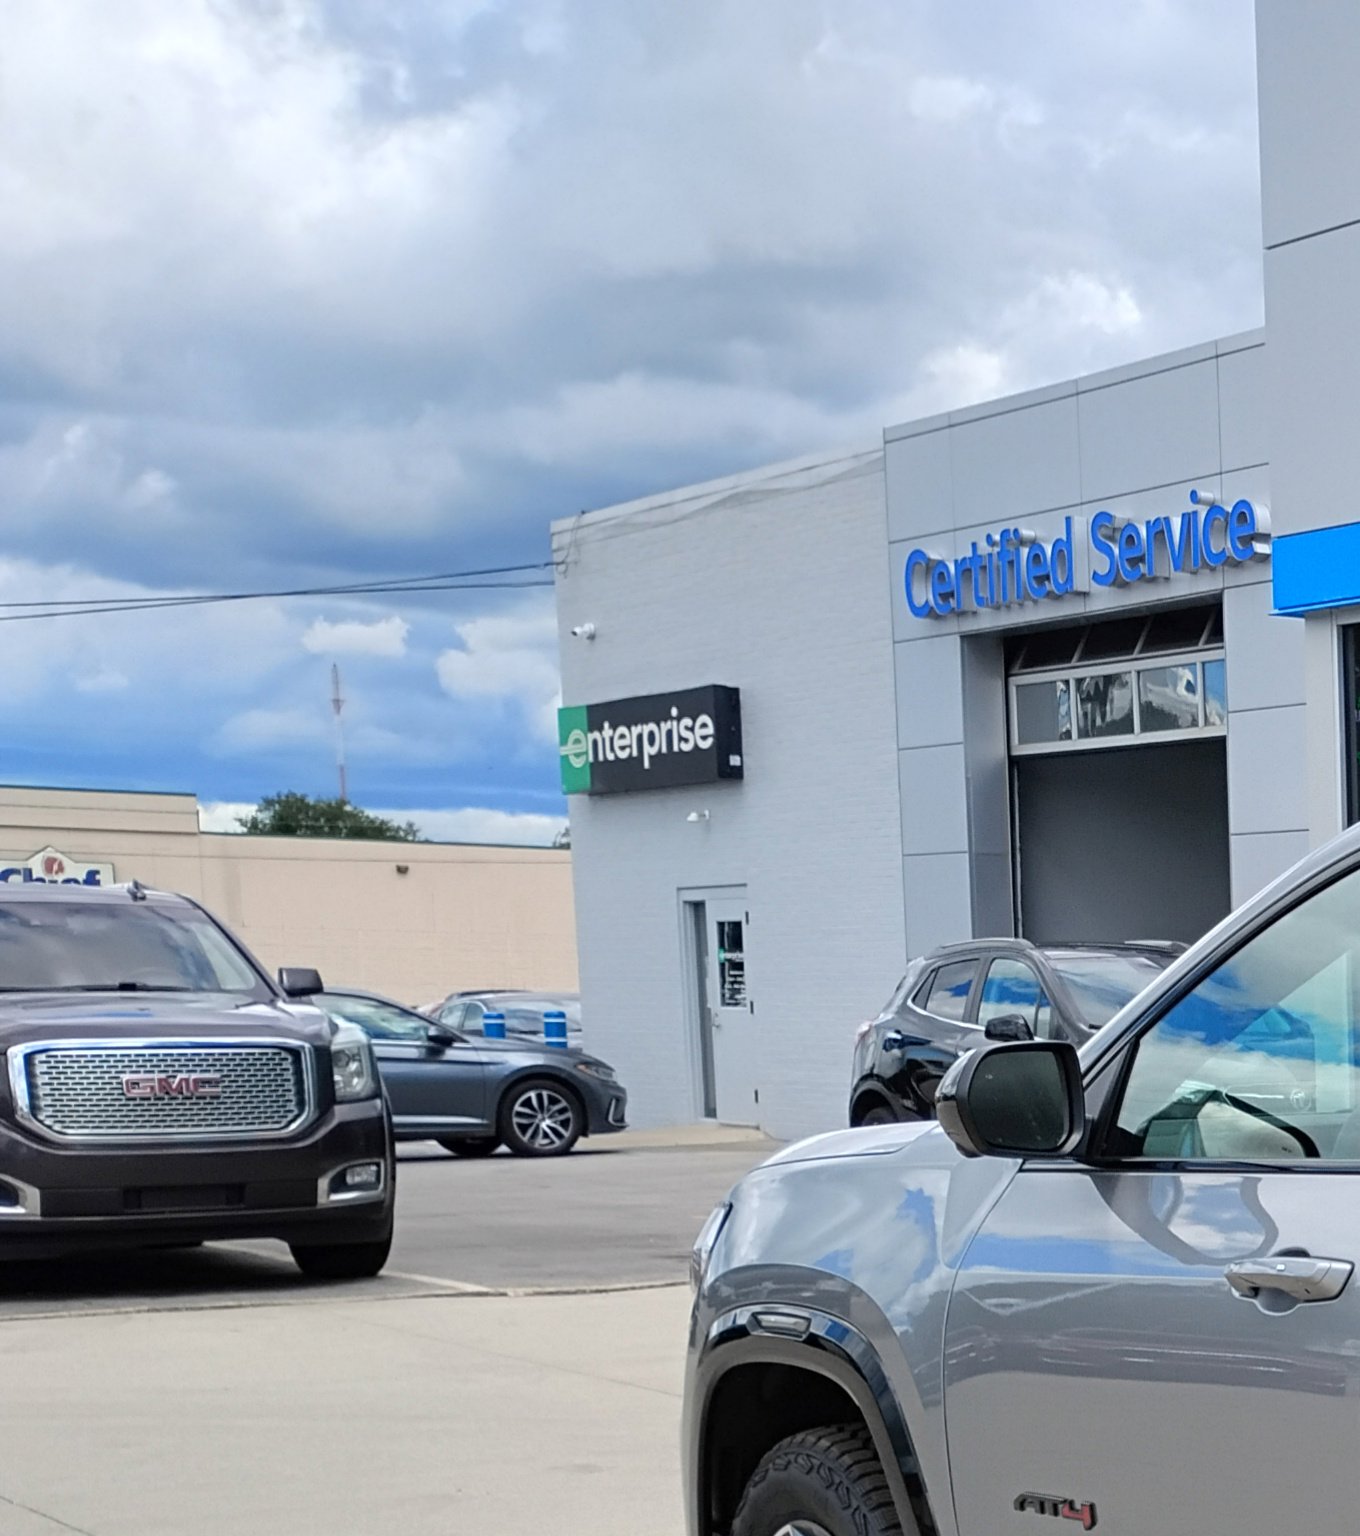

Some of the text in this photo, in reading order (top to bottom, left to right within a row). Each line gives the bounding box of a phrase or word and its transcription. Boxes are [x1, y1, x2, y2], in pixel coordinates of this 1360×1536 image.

[905, 489, 1261, 619] Certified Service
[560, 706, 715, 769] enterprise
[122, 1074, 221, 1097] GMC
[1013, 1491, 1099, 1531] AT4
